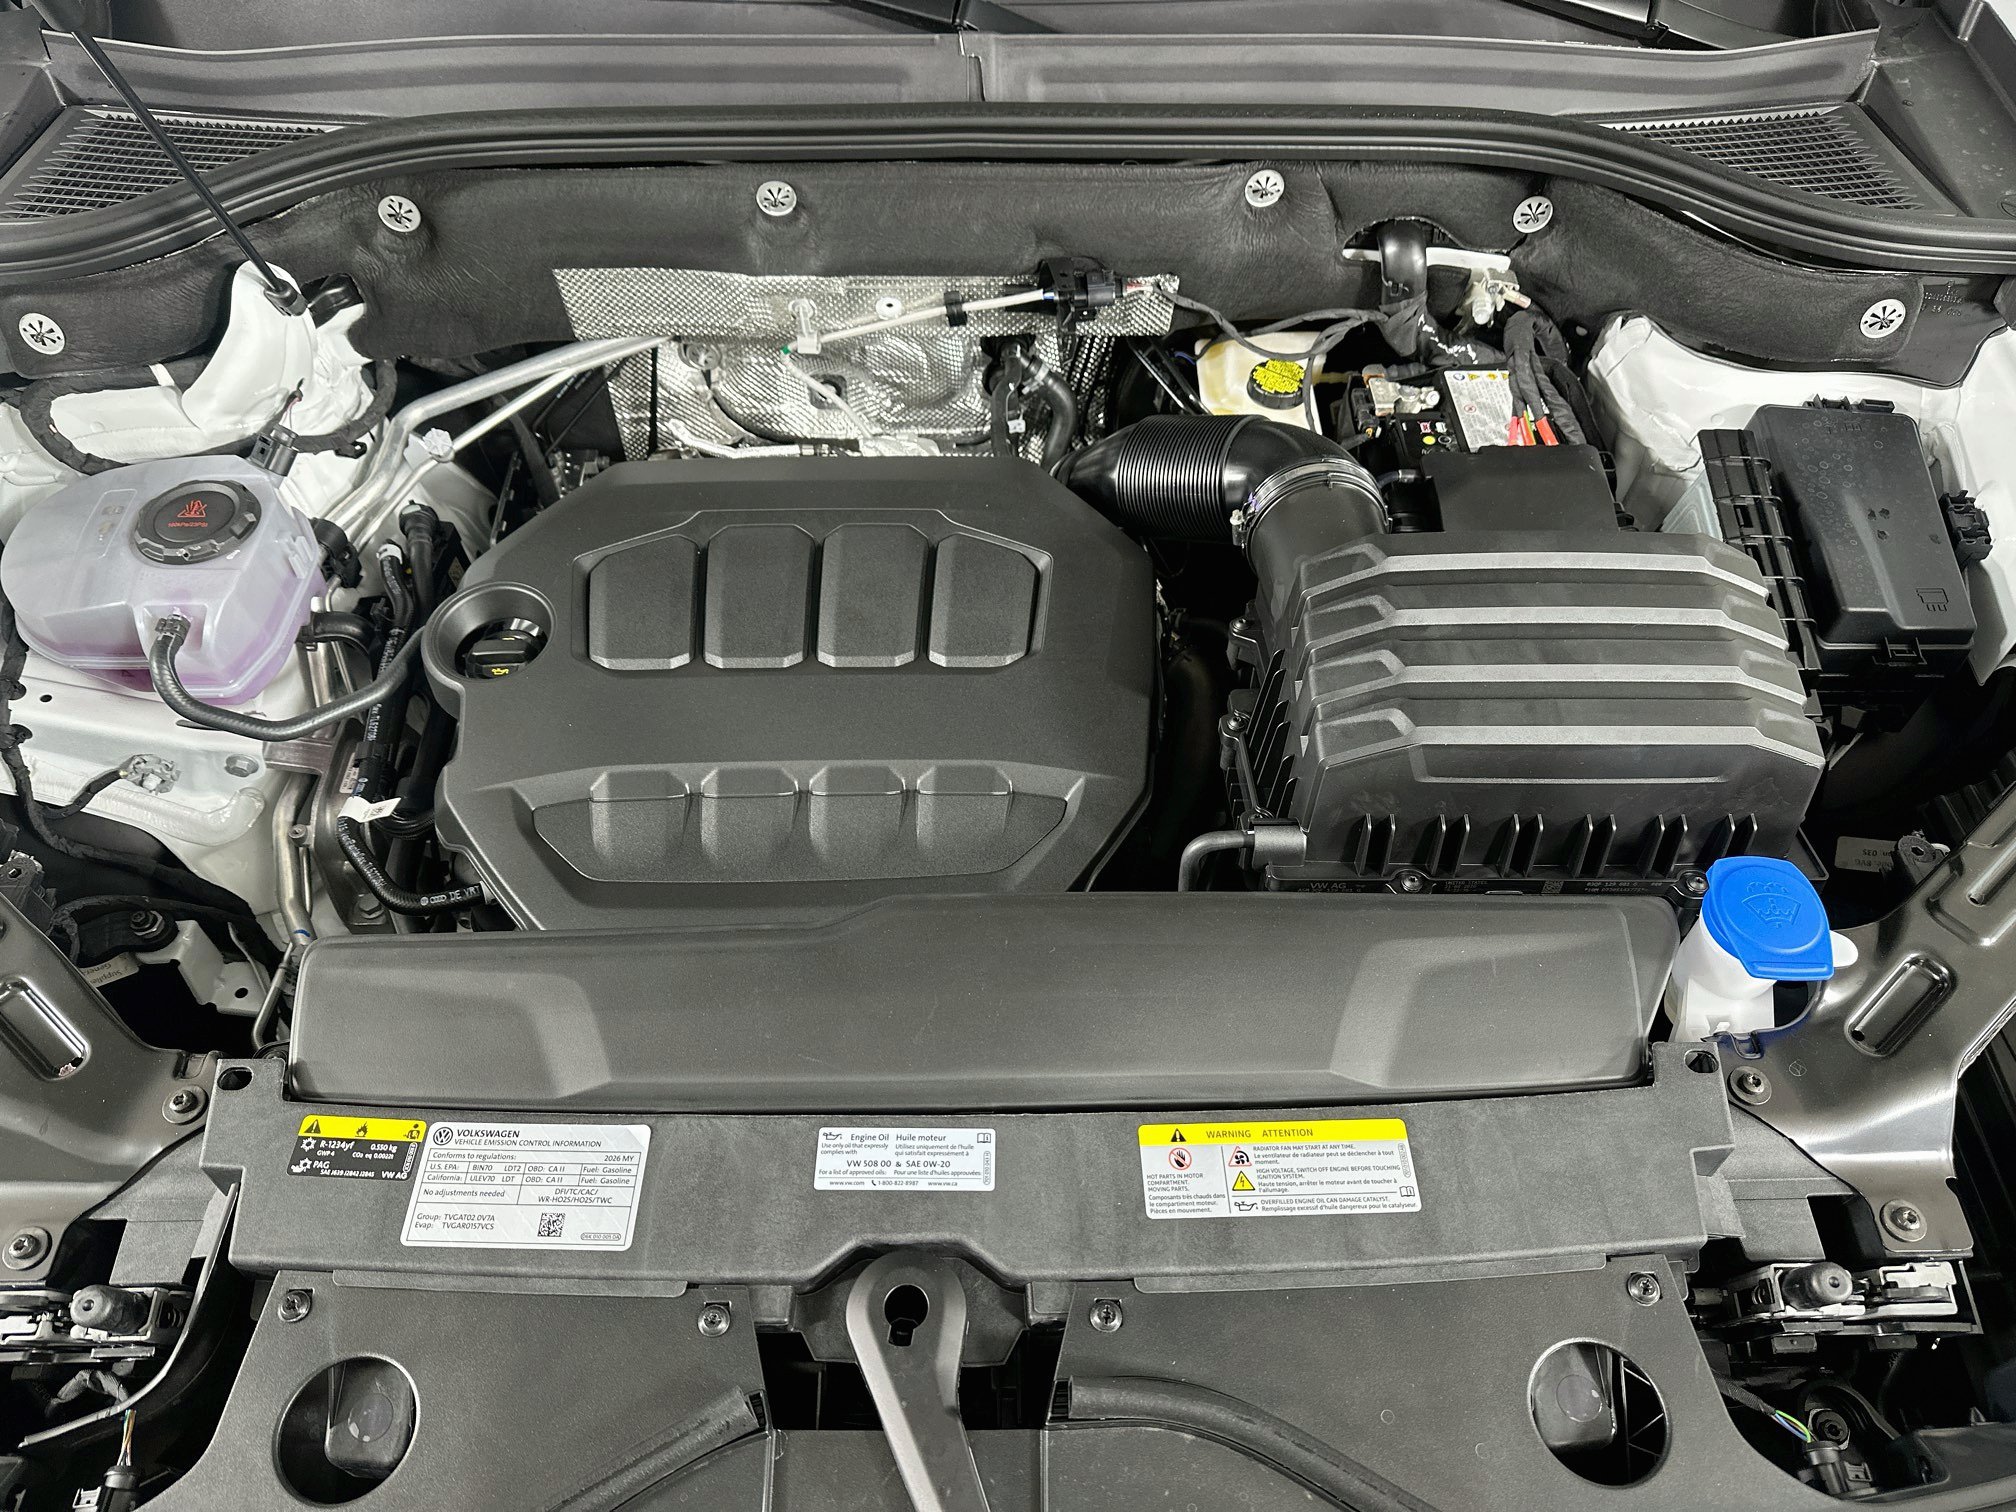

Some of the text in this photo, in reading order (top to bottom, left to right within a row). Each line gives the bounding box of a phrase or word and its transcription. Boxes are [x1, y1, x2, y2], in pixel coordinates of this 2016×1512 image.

[449, 886, 481, 900] DE VRT
[458, 1130, 519, 1138] VOLKSWAGEN
[1206, 1130, 1251, 1138] WARNING
[1263, 1129, 1313, 1137] ATTENTION
[851, 1134, 876, 1142] Engine
[320, 1140, 354, 1151] R-1234yf
[389, 1144, 398, 1153] kg
[313, 1161, 330, 1169] PAG
[417, 1213, 442, 1221] Group:
